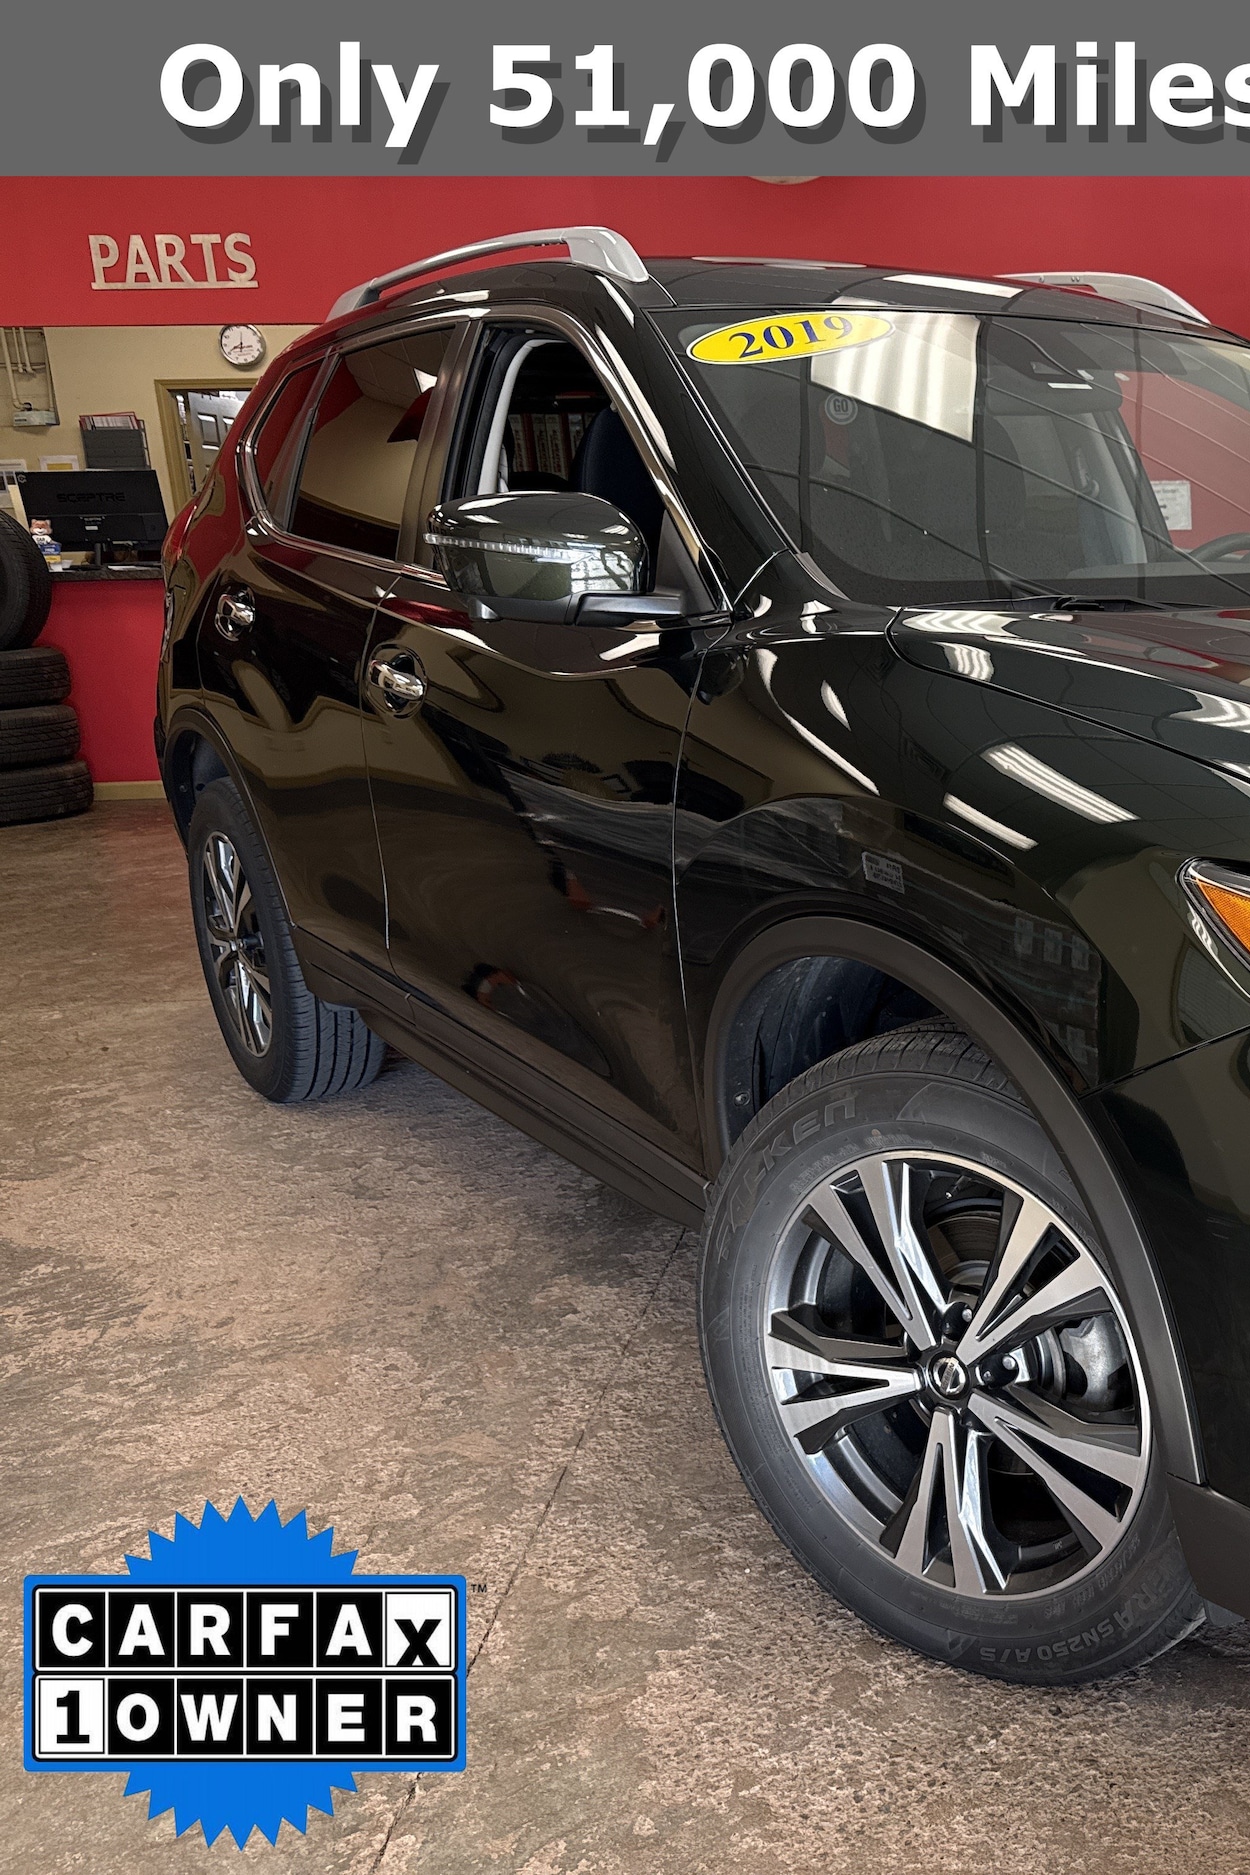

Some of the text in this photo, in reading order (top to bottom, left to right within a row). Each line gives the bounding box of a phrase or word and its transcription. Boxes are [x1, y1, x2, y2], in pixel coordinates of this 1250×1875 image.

[88, 232, 258, 288] PARTS
[729, 316, 853, 358] 2019
[833, 399, 848, 412] GO
[56, 492, 126, 503] SCEPTRE
[715, 1096, 857, 1265] FALKEN
[980, 1646, 1032, 1663] A/S
[1037, 1618, 1114, 1661] SN250
